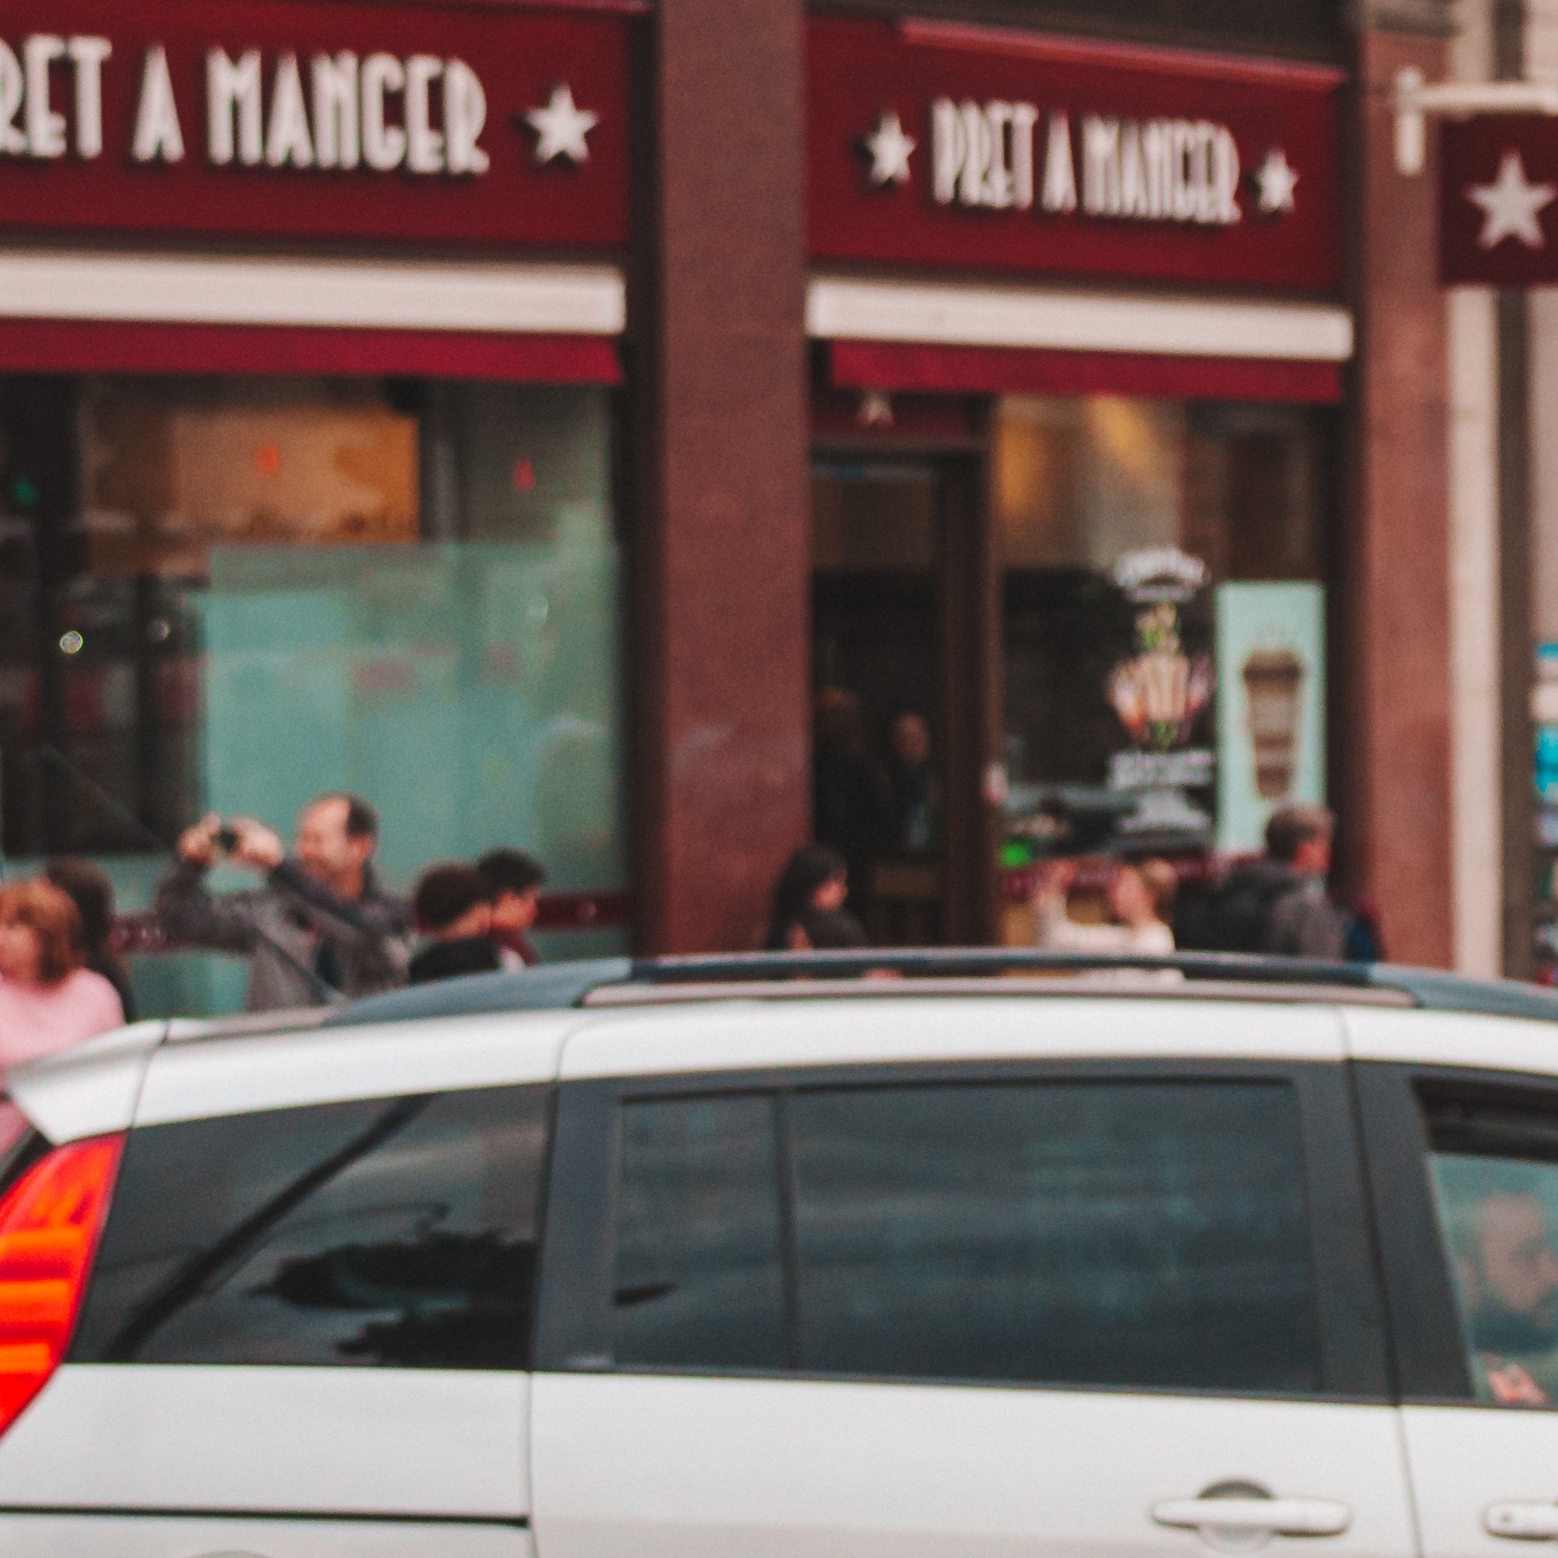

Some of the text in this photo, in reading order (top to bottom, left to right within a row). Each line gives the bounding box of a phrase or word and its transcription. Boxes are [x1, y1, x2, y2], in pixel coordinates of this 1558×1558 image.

[131, 43, 185, 164] A
[205, 45, 490, 174] MANGER
[932, 97, 1242, 225] PRET A MANGER
